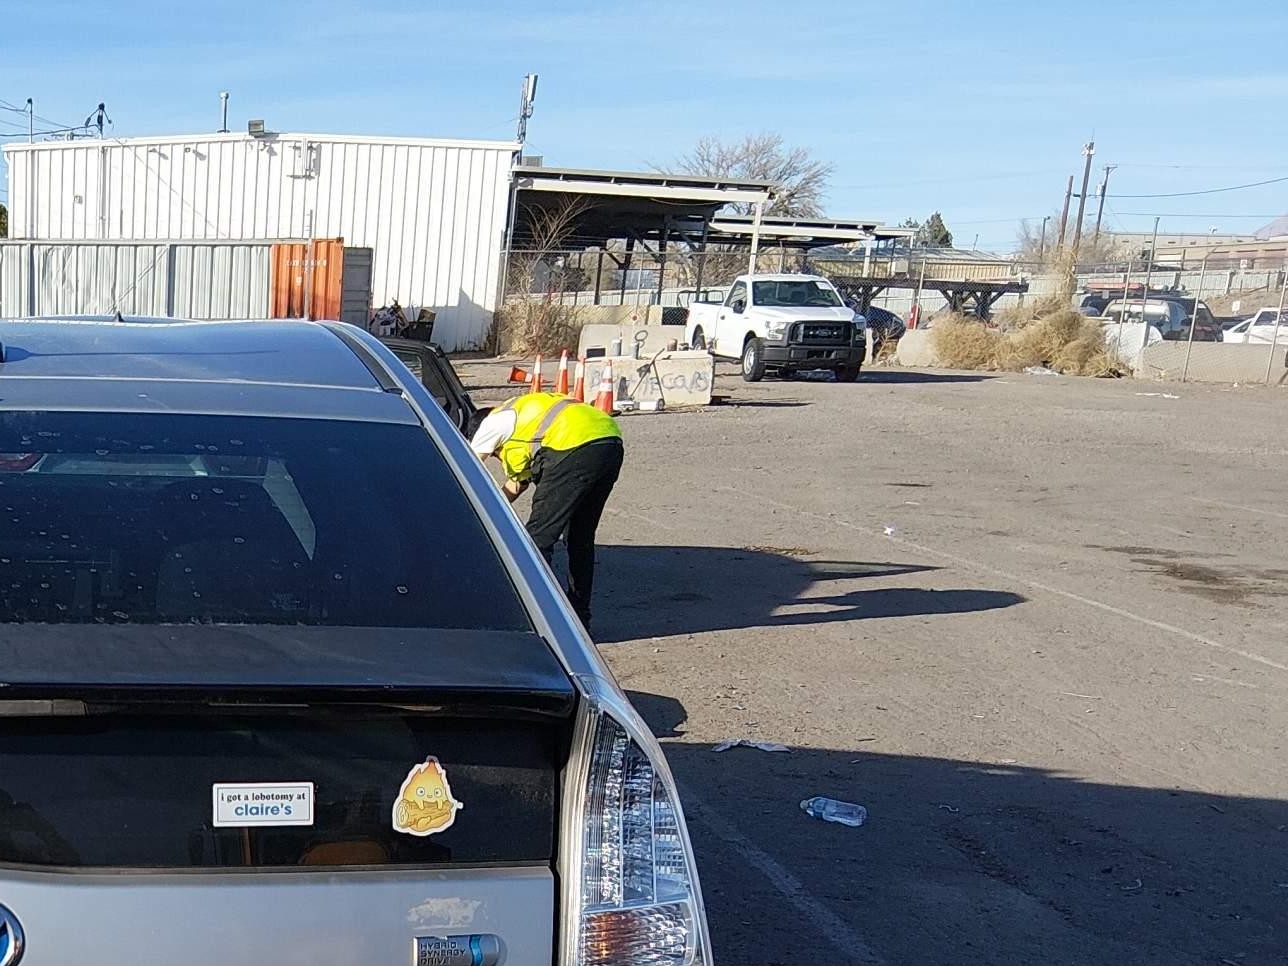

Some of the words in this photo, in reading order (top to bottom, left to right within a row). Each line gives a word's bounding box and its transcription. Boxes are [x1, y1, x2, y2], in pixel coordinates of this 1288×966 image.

[226, 793, 241, 803] got
[252, 792, 294, 802] lobotomy
[296, 792, 306, 801] at
[234, 803, 292, 816] claire's
[420, 941, 457, 950] HYBRID
[420, 949, 465, 958] SYNERGY
